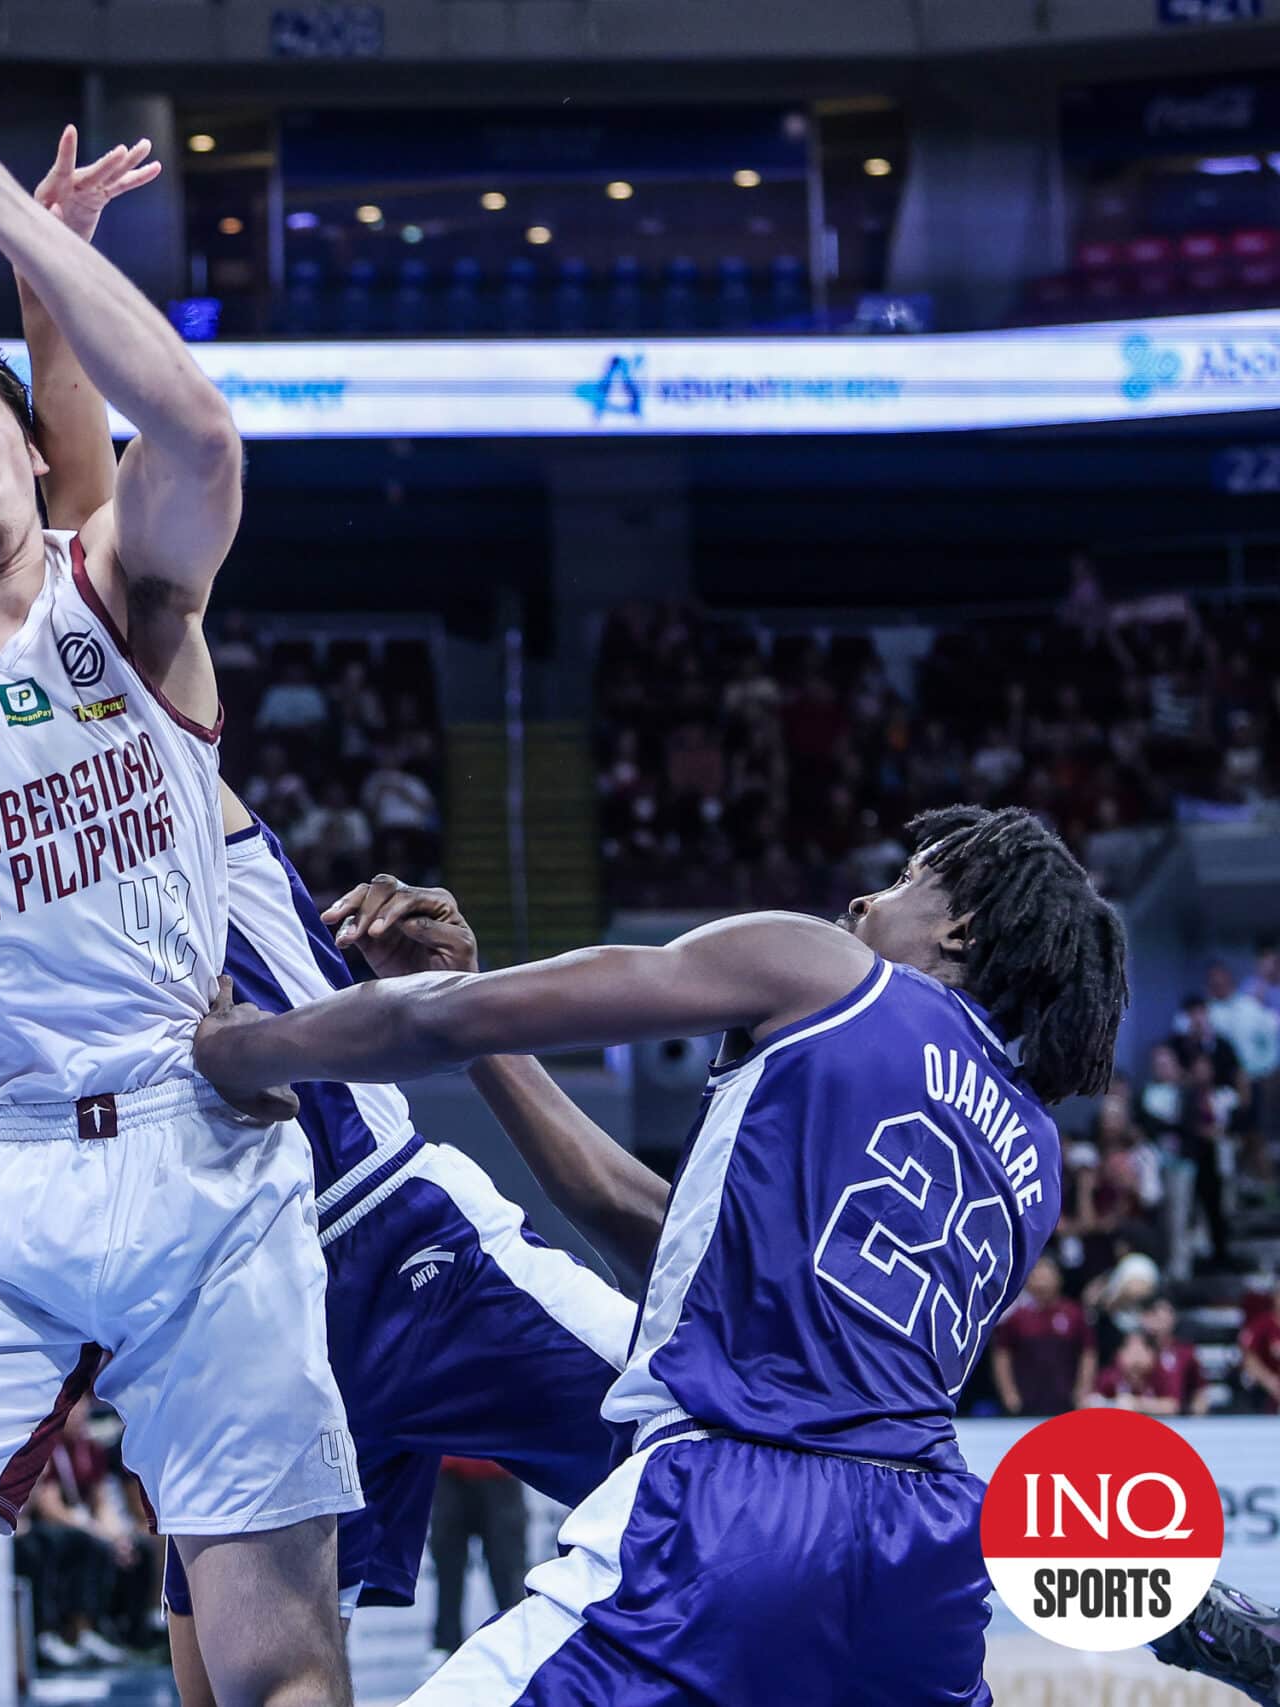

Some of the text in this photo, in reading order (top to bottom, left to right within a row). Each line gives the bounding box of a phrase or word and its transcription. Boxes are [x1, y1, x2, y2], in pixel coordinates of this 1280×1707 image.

[119, 869, 198, 985] 42
[923, 1042, 1043, 1217] OJARIKRE
[409, 1261, 440, 1292] ANTA
[813, 1111, 1014, 1396] 23
[320, 1428, 361, 1495] 4
